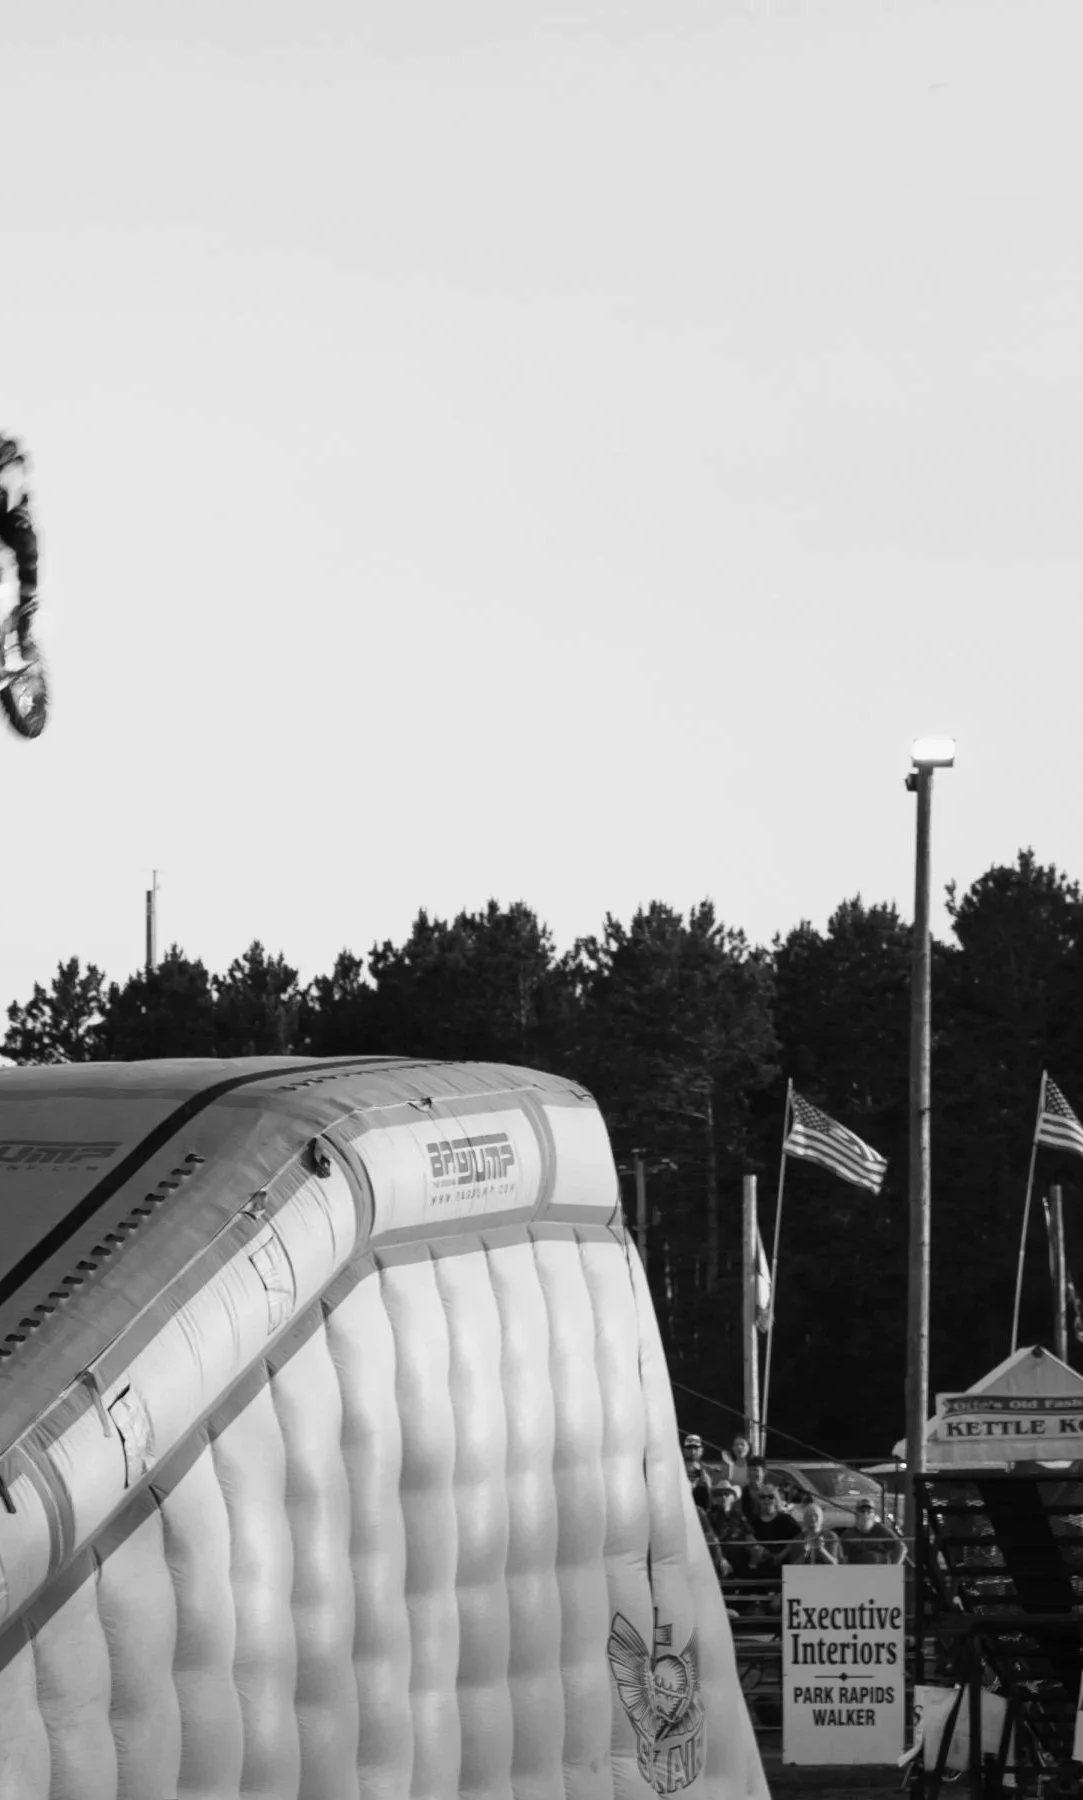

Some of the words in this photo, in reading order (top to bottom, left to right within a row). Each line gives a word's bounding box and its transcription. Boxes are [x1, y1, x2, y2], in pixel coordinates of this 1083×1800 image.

[946, 1419, 1046, 1438] KETTLE
[786, 1598, 902, 1630] Executive
[791, 1633, 898, 1665] Interiors
[793, 1686, 834, 1704] PARK
[839, 1686, 895, 1704] RAPIDS
[812, 1708, 876, 1726] WALKER
